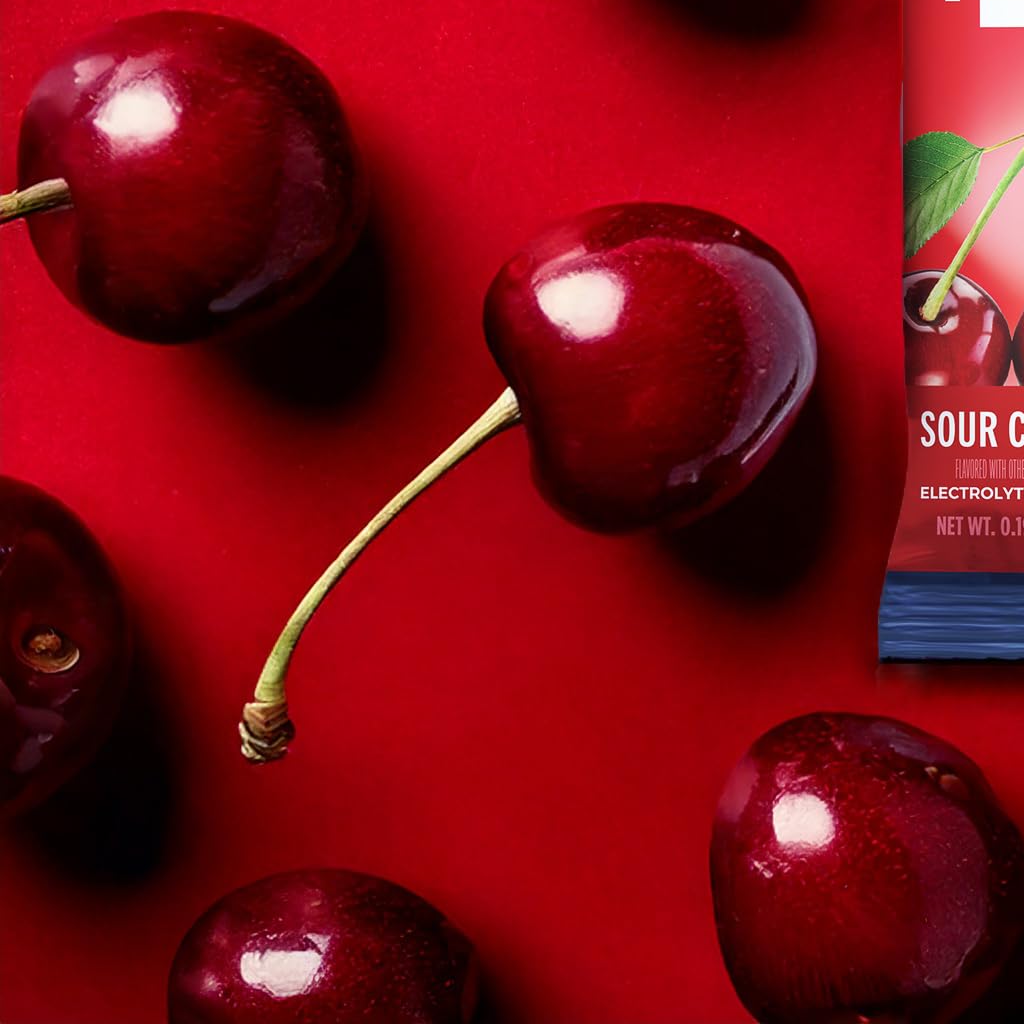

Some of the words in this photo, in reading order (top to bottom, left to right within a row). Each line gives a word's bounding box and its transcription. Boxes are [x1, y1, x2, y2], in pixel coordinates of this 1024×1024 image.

[920, 410, 998, 448] SOUR
[955, 458, 988, 480] FLAVORED
[988, 458, 1007, 480] WITH
[936, 516, 964, 536] NET
[967, 516, 996, 536] WT.
